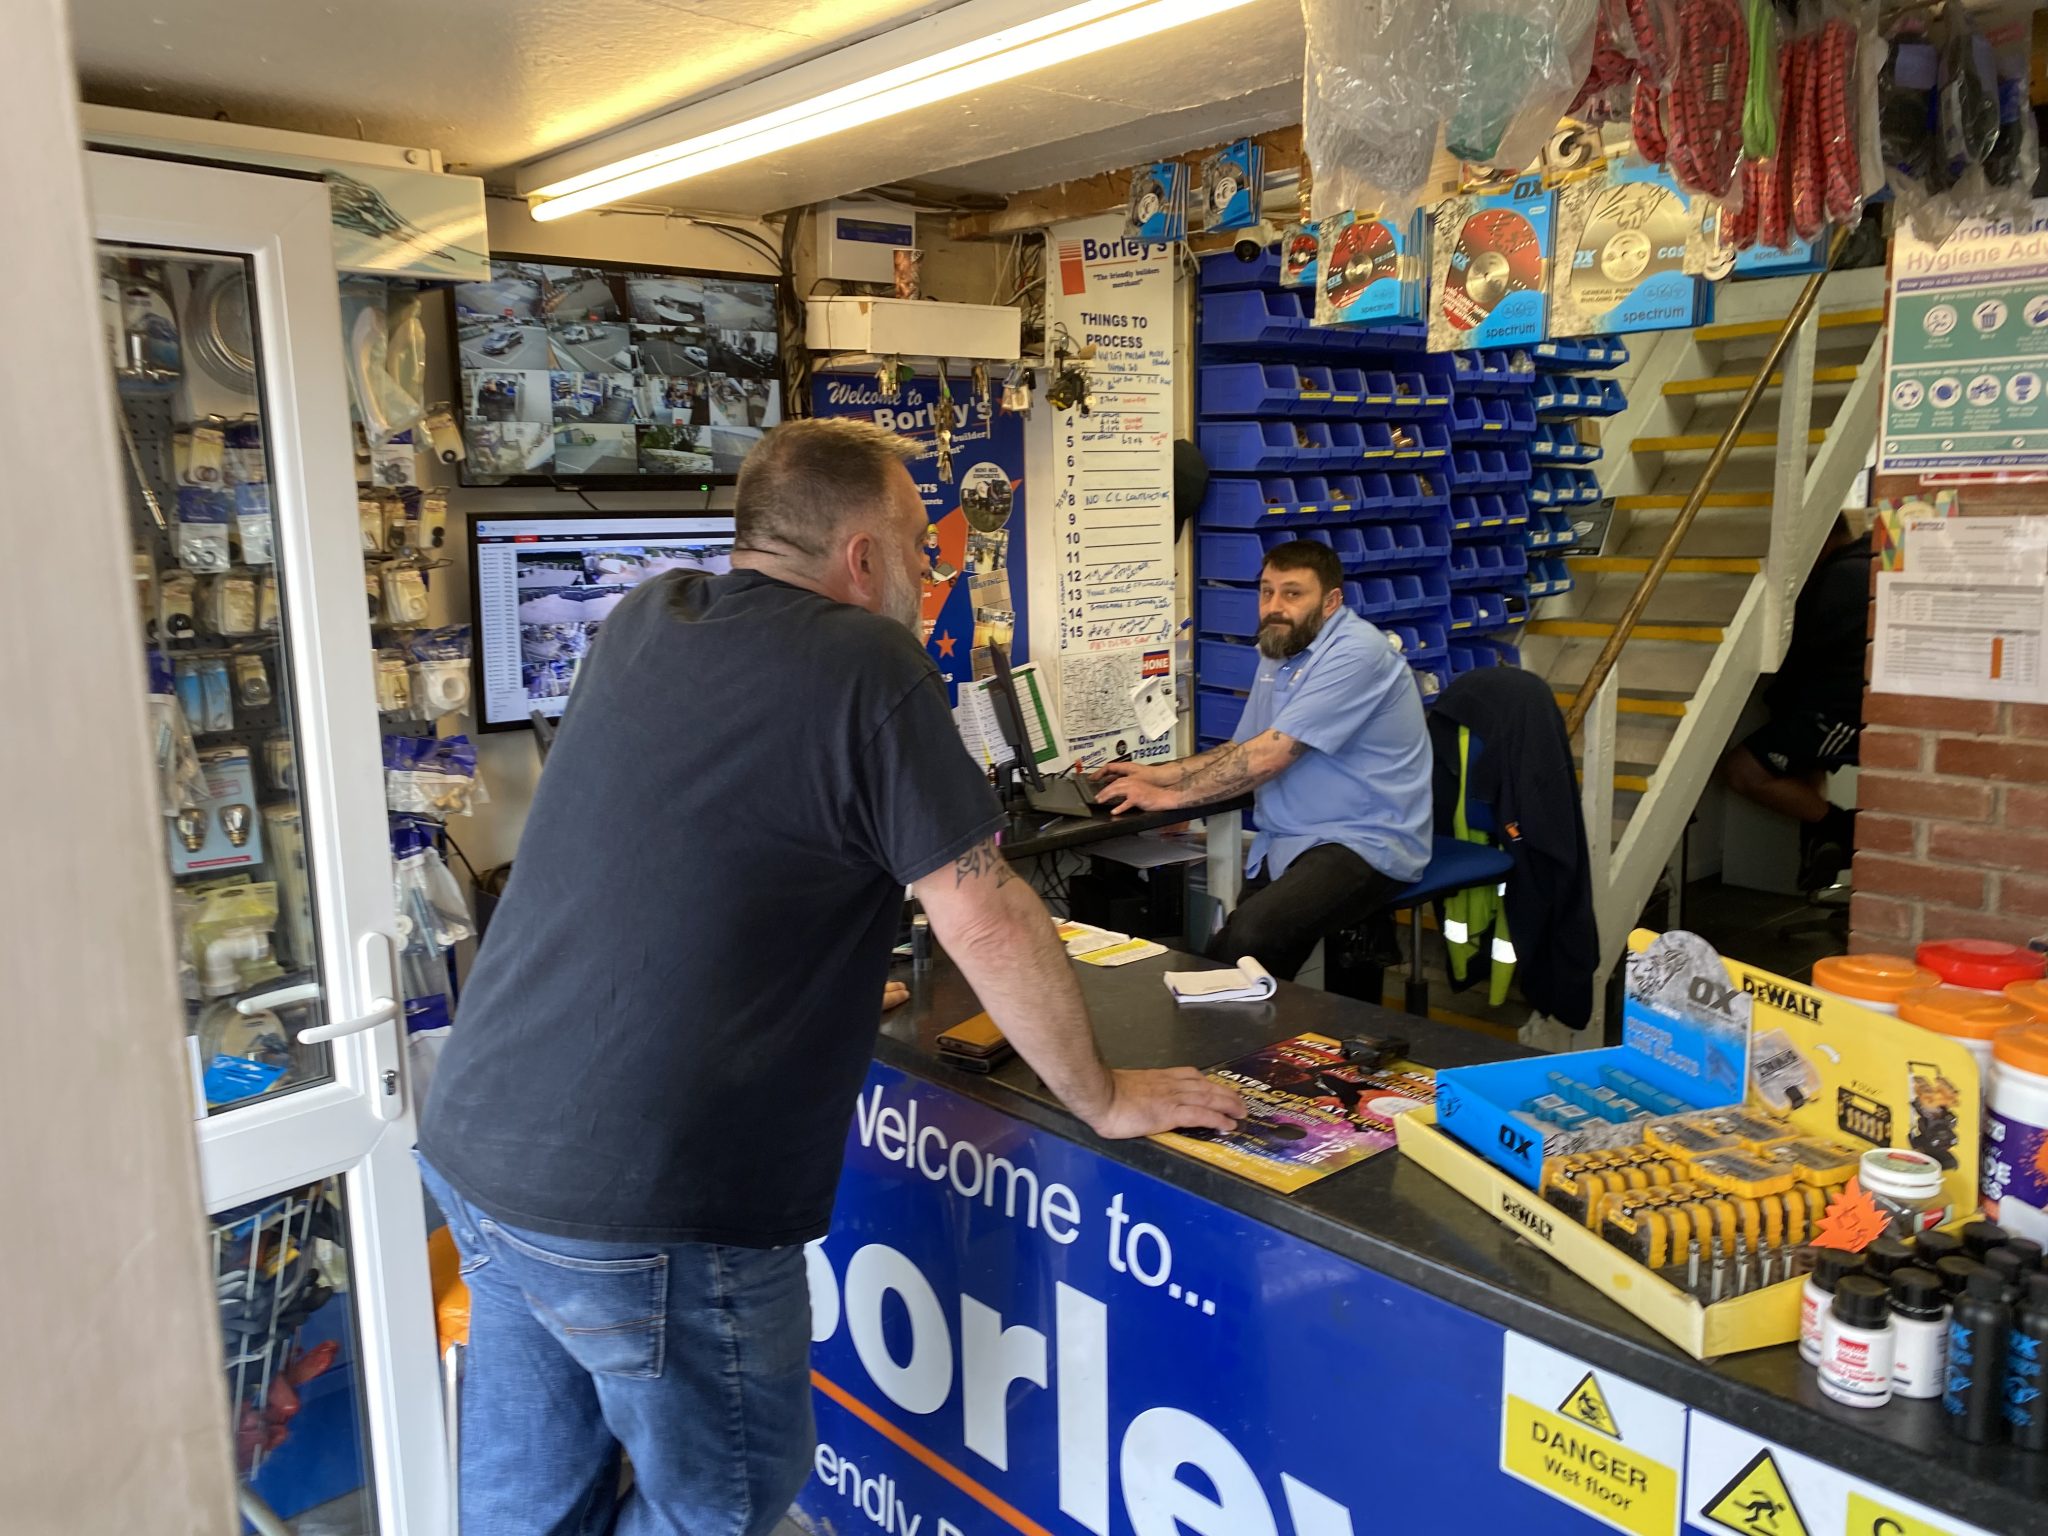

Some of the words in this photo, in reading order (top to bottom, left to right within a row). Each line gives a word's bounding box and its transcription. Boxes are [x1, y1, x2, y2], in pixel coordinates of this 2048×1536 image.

[1514, 181, 1543, 201] OX
[1083, 236, 1168, 260] Borleys
[1906, 244, 2001, 274] Hygiene
[1080, 312, 1129, 328] THINGS
[1132, 316, 1148, 329] TO
[1623, 307, 1685, 324] spectrum
[1485, 323, 1536, 338] spectrum
[1086, 333, 1144, 349] PROCESS
[906, 388, 923, 407] to
[873, 396, 993, 432] Borly's
[1066, 416, 1073, 427] 4
[1066, 436, 1074, 448] 5
[1067, 455, 1075, 467] 6
[1067, 474, 1075, 487] 7
[1068, 494, 1076, 506] 8
[1068, 513, 1076, 525] 9
[1065, 532, 1080, 544] 10
[1066, 551, 1080, 563] 11
[1067, 570, 1082, 582] 12
[1067, 589, 1082, 601] 13
[1068, 607, 1083, 619] 14
[1069, 626, 1083, 638] 15
[1688, 975, 1744, 1015] OX
[1217, 1070, 1272, 1091] GATES
[1271, 1090, 1320, 1107] OPEN
[1319, 1104, 1349, 1115] AT
[1347, 1113, 1395, 1133] 12PM
[1293, 1139, 1348, 1160] 12
[1500, 1125, 1535, 1159] OX
[1502, 1193, 1554, 1242] DEWALT
[1531, 1420, 1649, 1494] DANGER
[1543, 1454, 1581, 1487] Wet
[1584, 1470, 1633, 1511] floor
